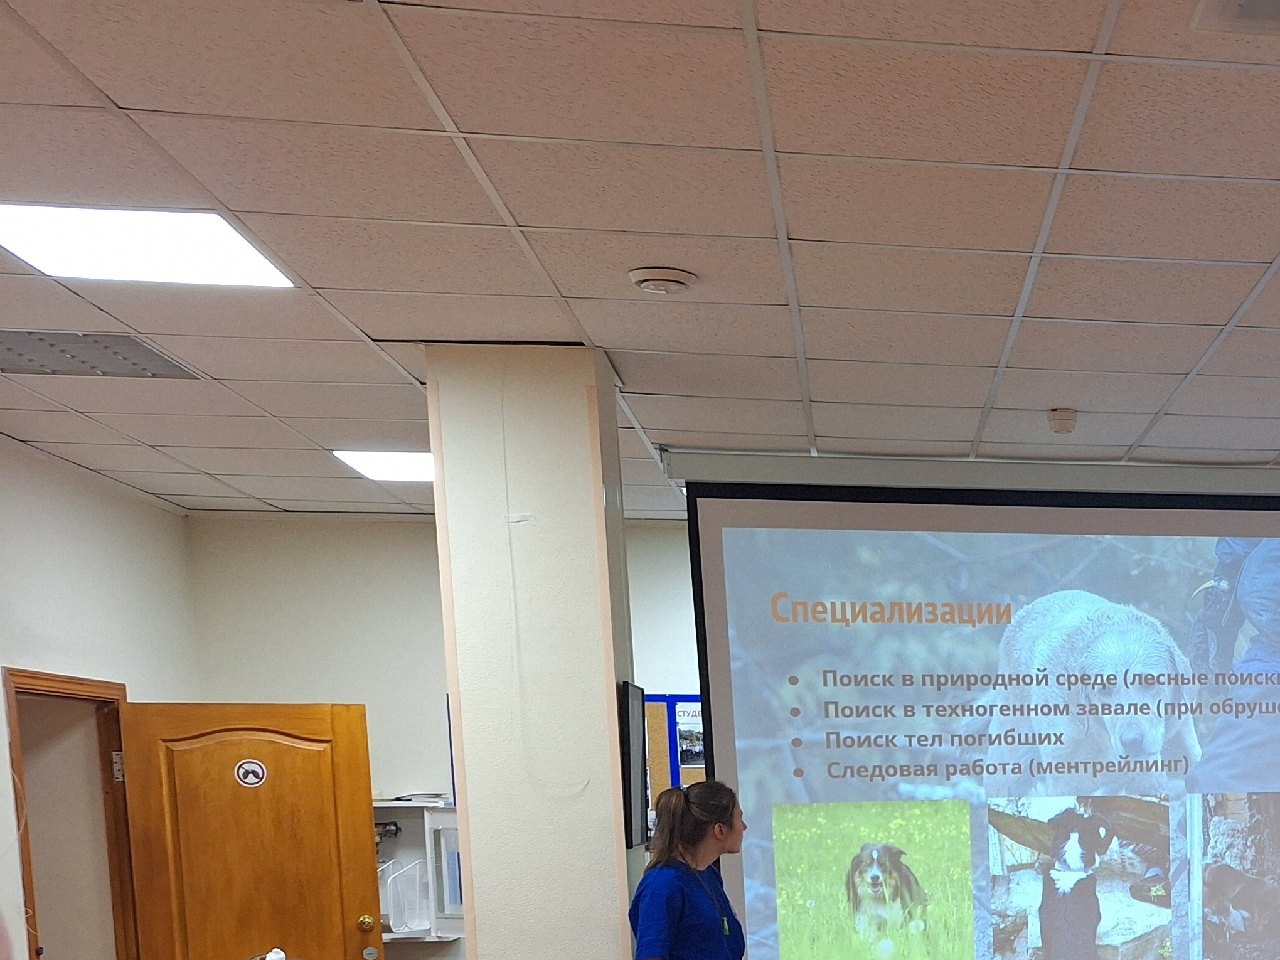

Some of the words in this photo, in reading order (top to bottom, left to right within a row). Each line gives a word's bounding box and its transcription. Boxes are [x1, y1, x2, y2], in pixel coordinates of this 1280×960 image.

[770, 592, 1012, 628] Специализации
[822, 669, 895, 687] Поиск
[902, 673, 915, 687] в
[921, 668, 1049, 691] природной
[1056, 672, 1118, 691] среде
[1123, 669, 1209, 688] (лесные
[823, 701, 897, 719] Поиск
[903, 705, 916, 718] в
[922, 702, 1070, 718] техногенном
[1076, 702, 1151, 717] завале
[1156, 700, 1204, 720] (при
[825, 731, 898, 749] Поиск
[904, 734, 944, 748] тел
[950, 728, 1065, 747] погибших
[827, 761, 938, 782] Следовая
[945, 758, 1023, 782] работа
[1029, 755, 1190, 777] (ментрейлинг)
